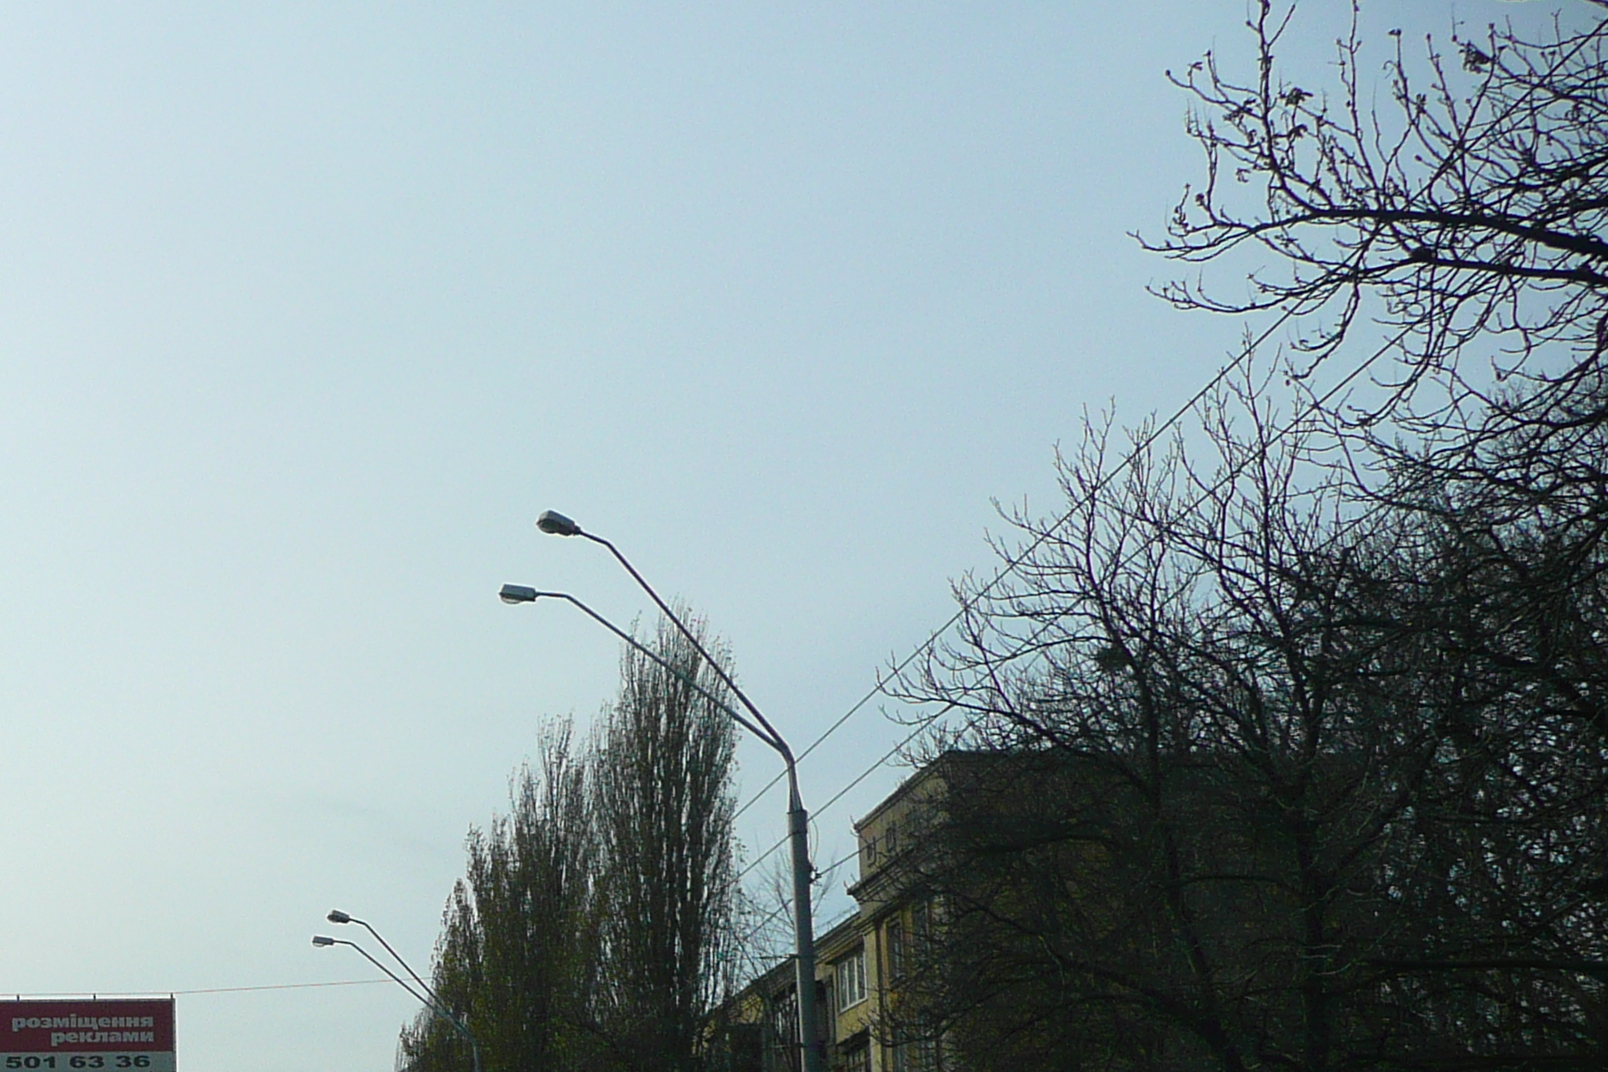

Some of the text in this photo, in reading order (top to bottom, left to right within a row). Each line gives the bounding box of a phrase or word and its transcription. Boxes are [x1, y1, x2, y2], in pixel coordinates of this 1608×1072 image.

[11, 1013, 154, 1032] розміщення
[50, 1031, 155, 1047] реклами
[5, 1054, 151, 1069] 501 63 36
